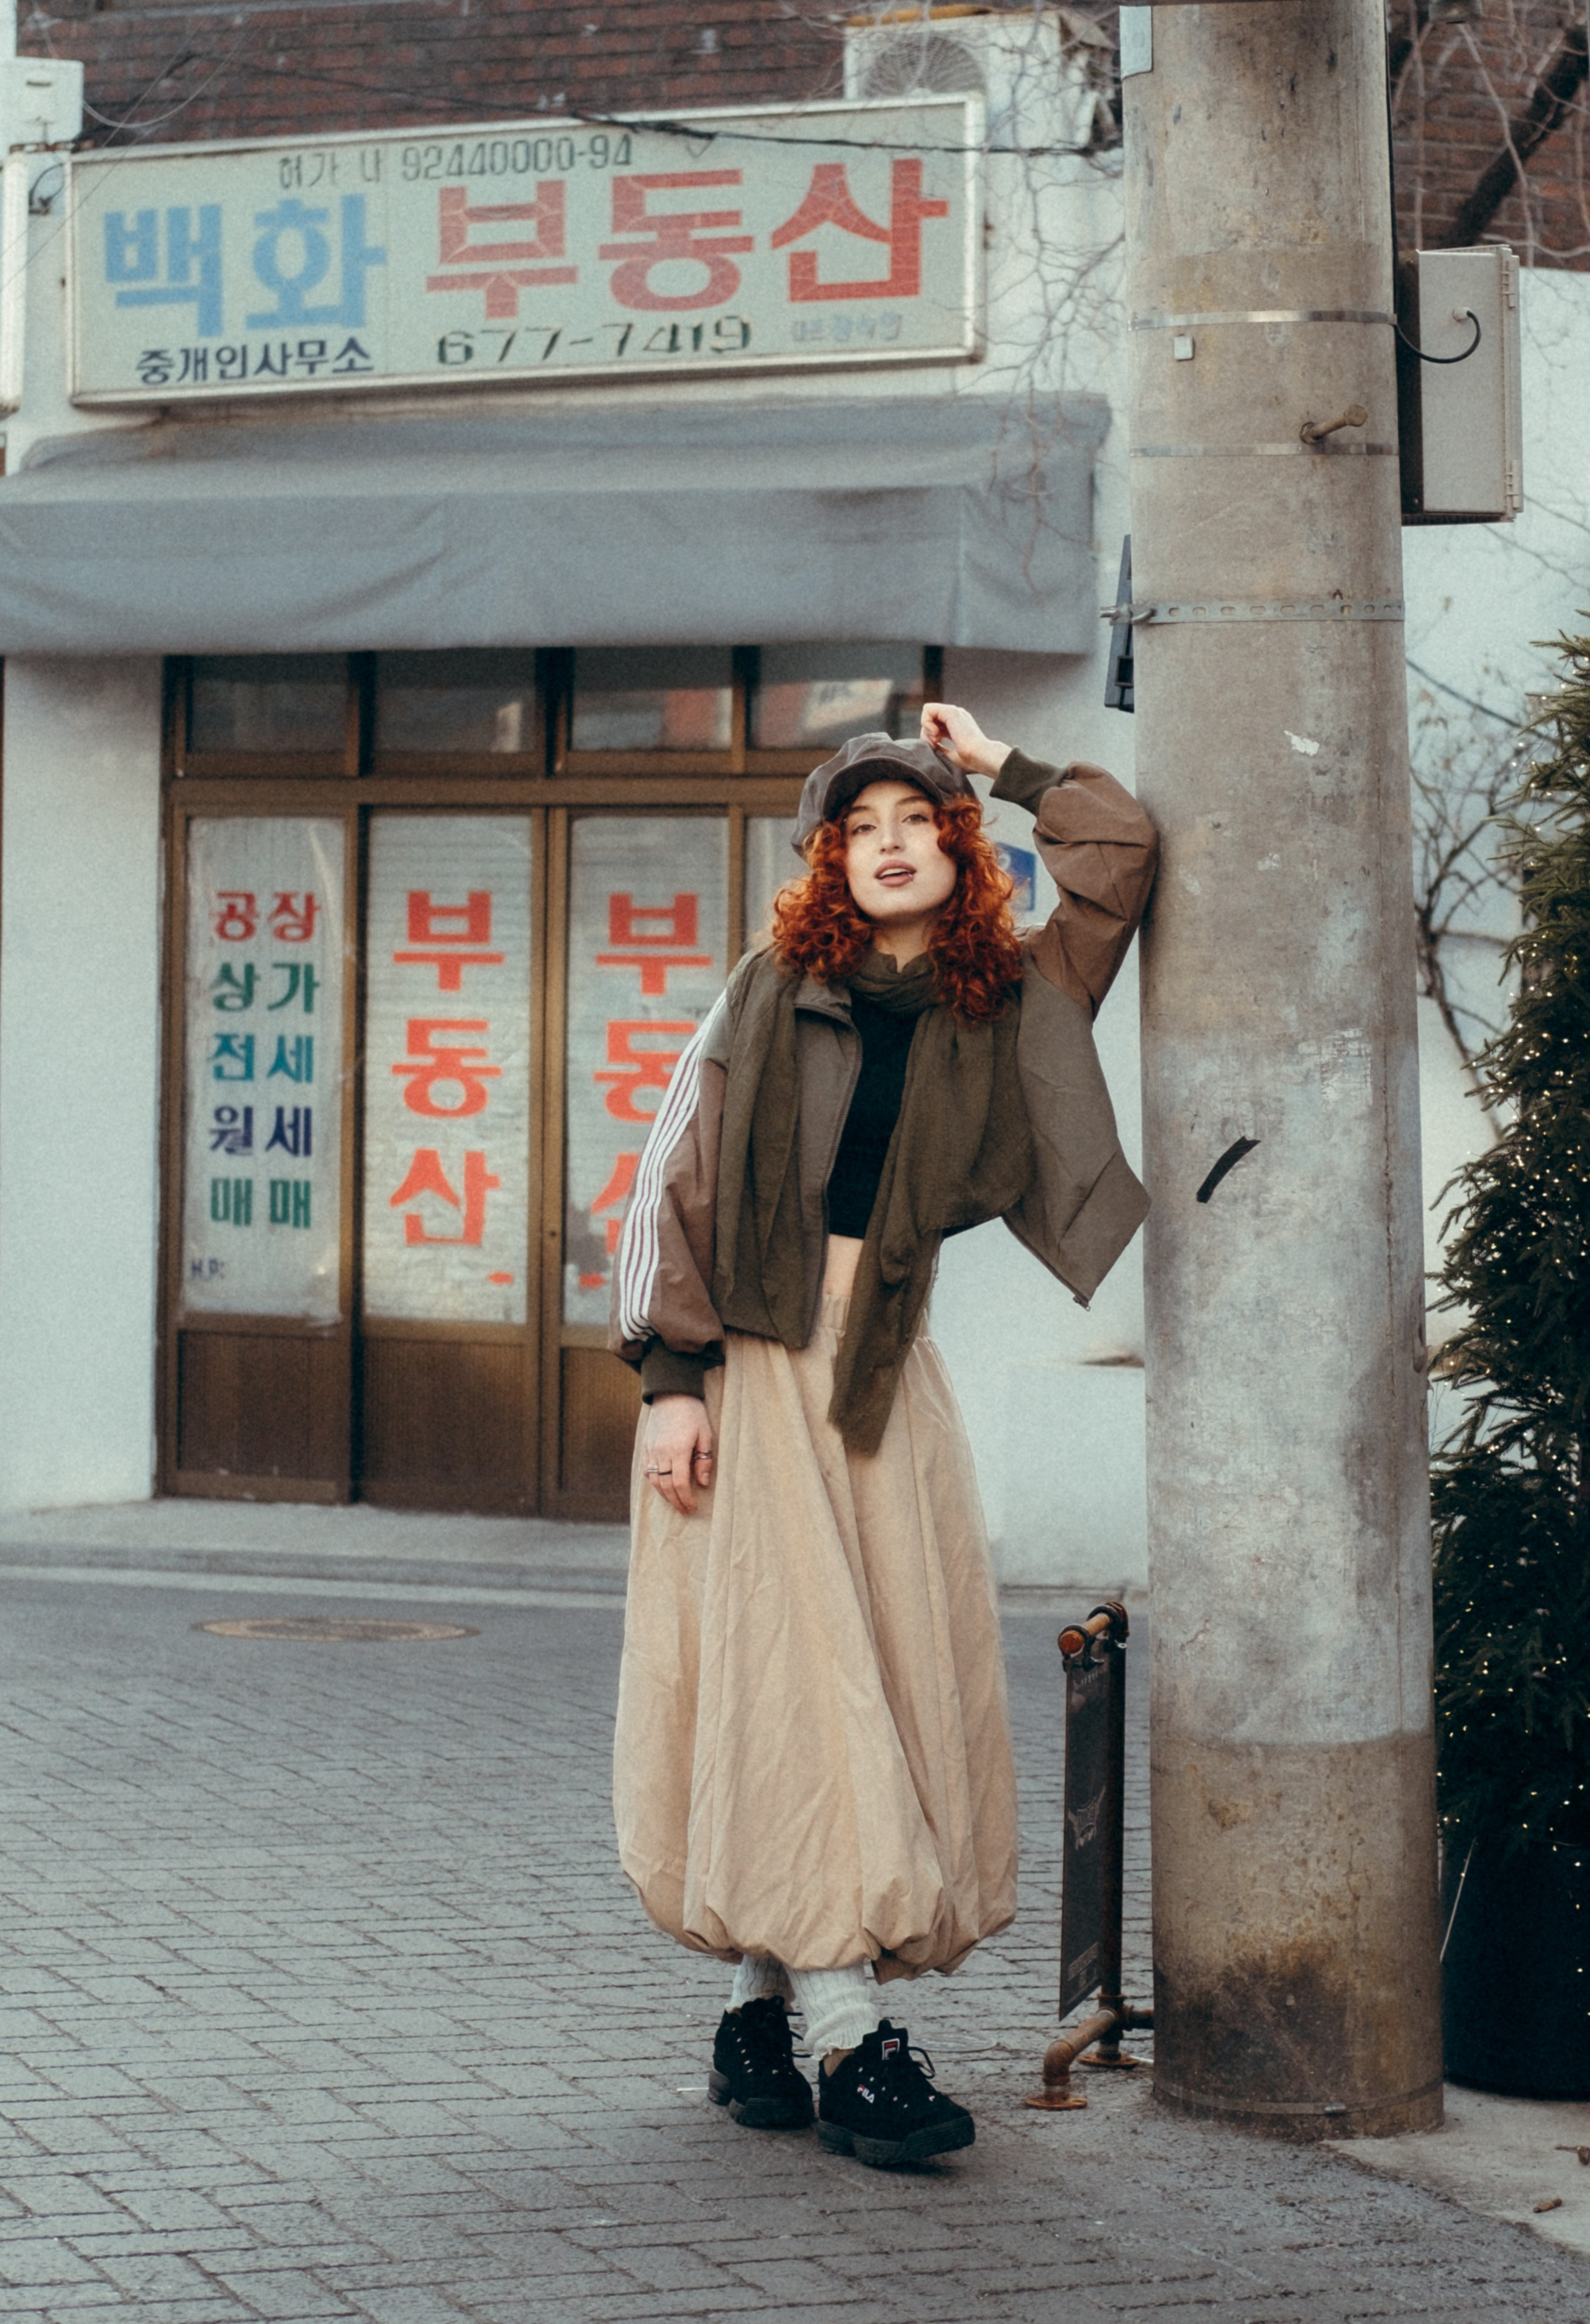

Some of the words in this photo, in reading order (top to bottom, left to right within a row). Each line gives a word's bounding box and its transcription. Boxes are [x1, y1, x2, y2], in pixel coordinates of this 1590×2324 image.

[401, 134, 632, 181] 92440000-94
[104, 193, 388, 337] 백화
[425, 158, 949, 320] 부동산
[135, 336, 375, 386] 중개인사무소
[438, 315, 752, 365] 677-7419
[212, 890, 321, 943] 공장
[209, 961, 320, 1014] 상가
[207, 1032, 314, 1084] 전세
[389, 889, 505, 1247] 부동산
[209, 1105, 313, 1157] 월세
[209, 1177, 312, 1229] 매매
[857, 2084, 874, 2104] FILA
